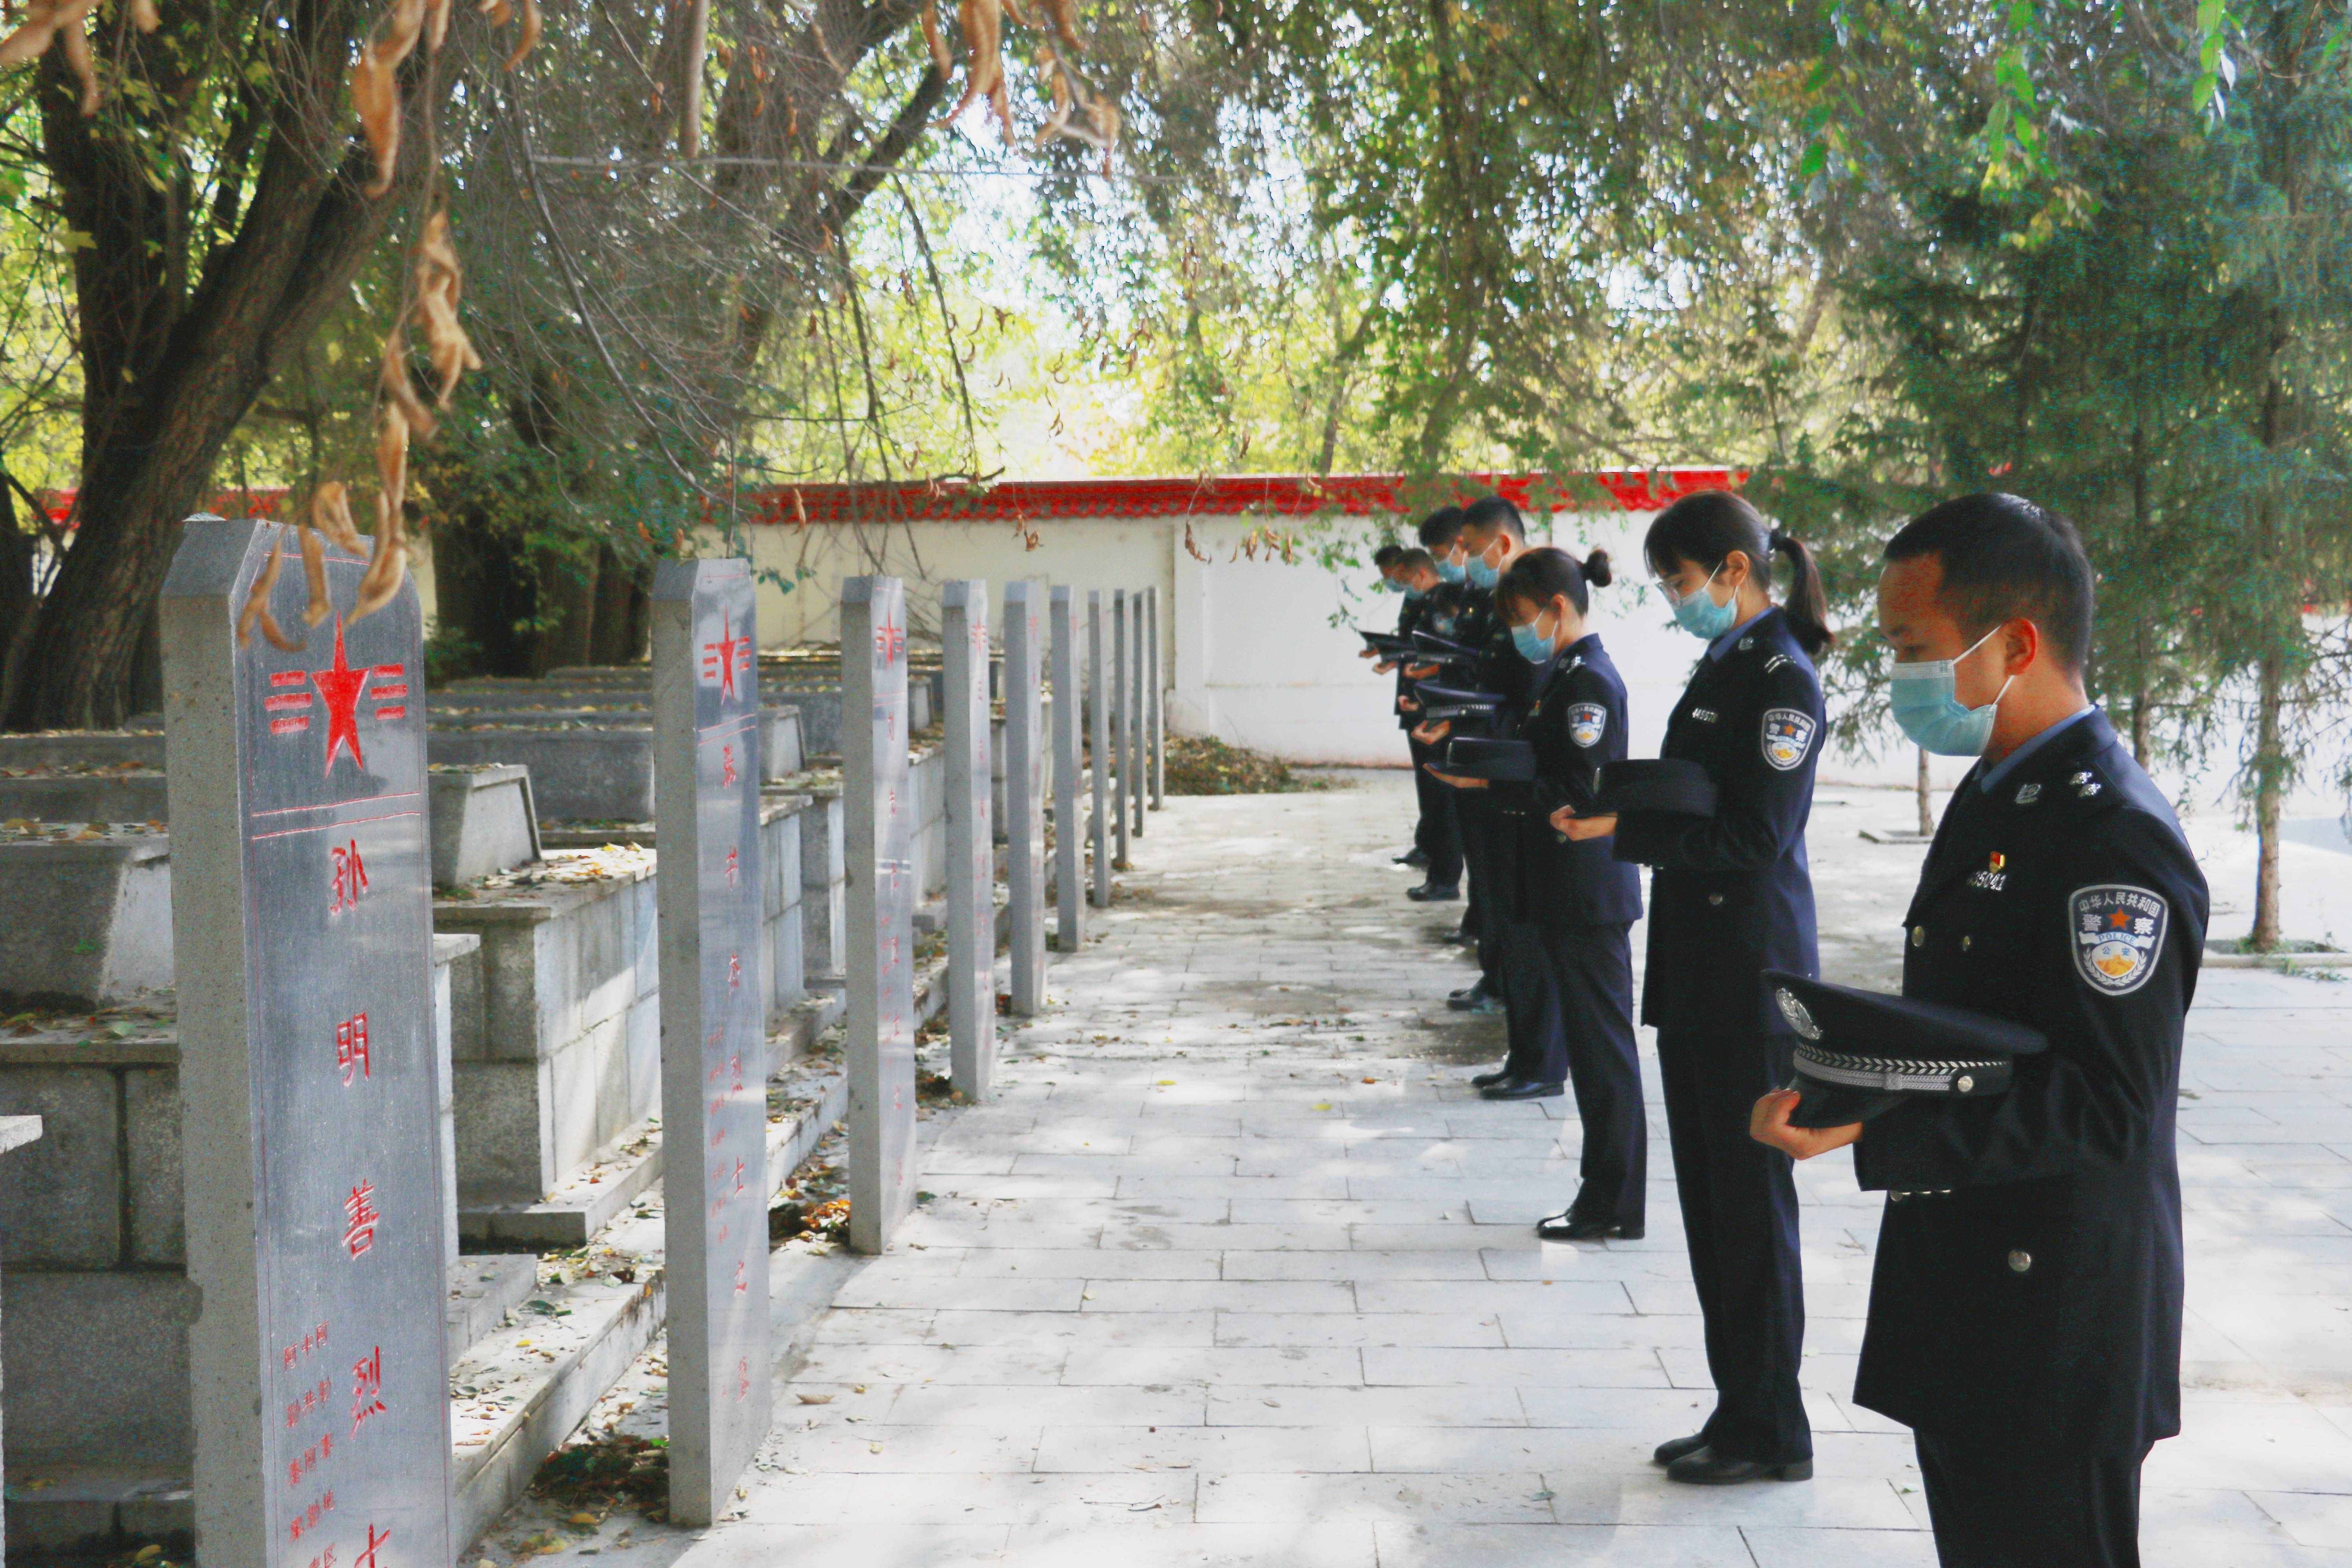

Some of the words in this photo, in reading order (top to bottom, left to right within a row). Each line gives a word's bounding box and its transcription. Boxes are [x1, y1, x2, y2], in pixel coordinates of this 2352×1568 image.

[2079, 892, 2161, 918] 中华人民共和国
[2098, 933, 2137, 944] POLICE
